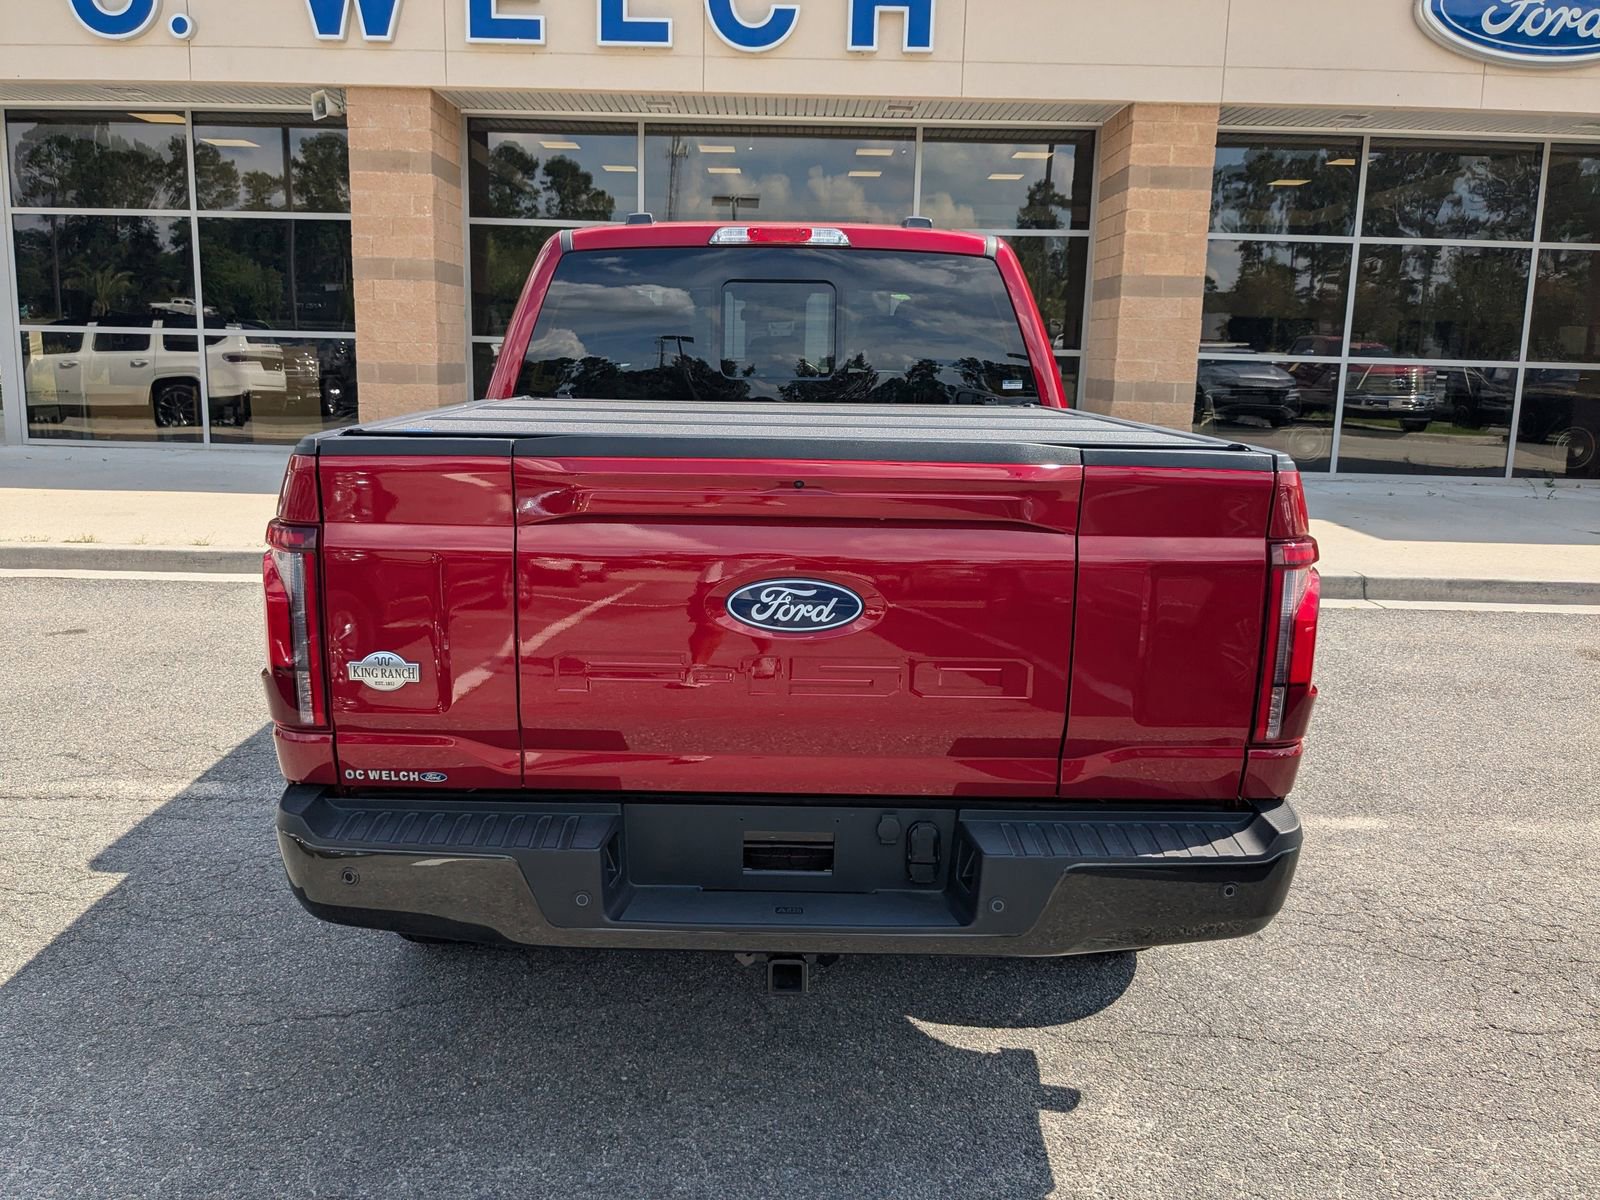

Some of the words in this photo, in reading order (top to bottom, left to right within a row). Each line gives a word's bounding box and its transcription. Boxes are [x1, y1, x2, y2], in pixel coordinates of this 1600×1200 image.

[1481, 0, 1600, 38] For
[751, 586, 838, 622] Ford
[353, 665, 378, 678] KING
[381, 667, 415, 679] RANCH
[345, 769, 364, 779] OC
[368, 770, 418, 781] WELCH
